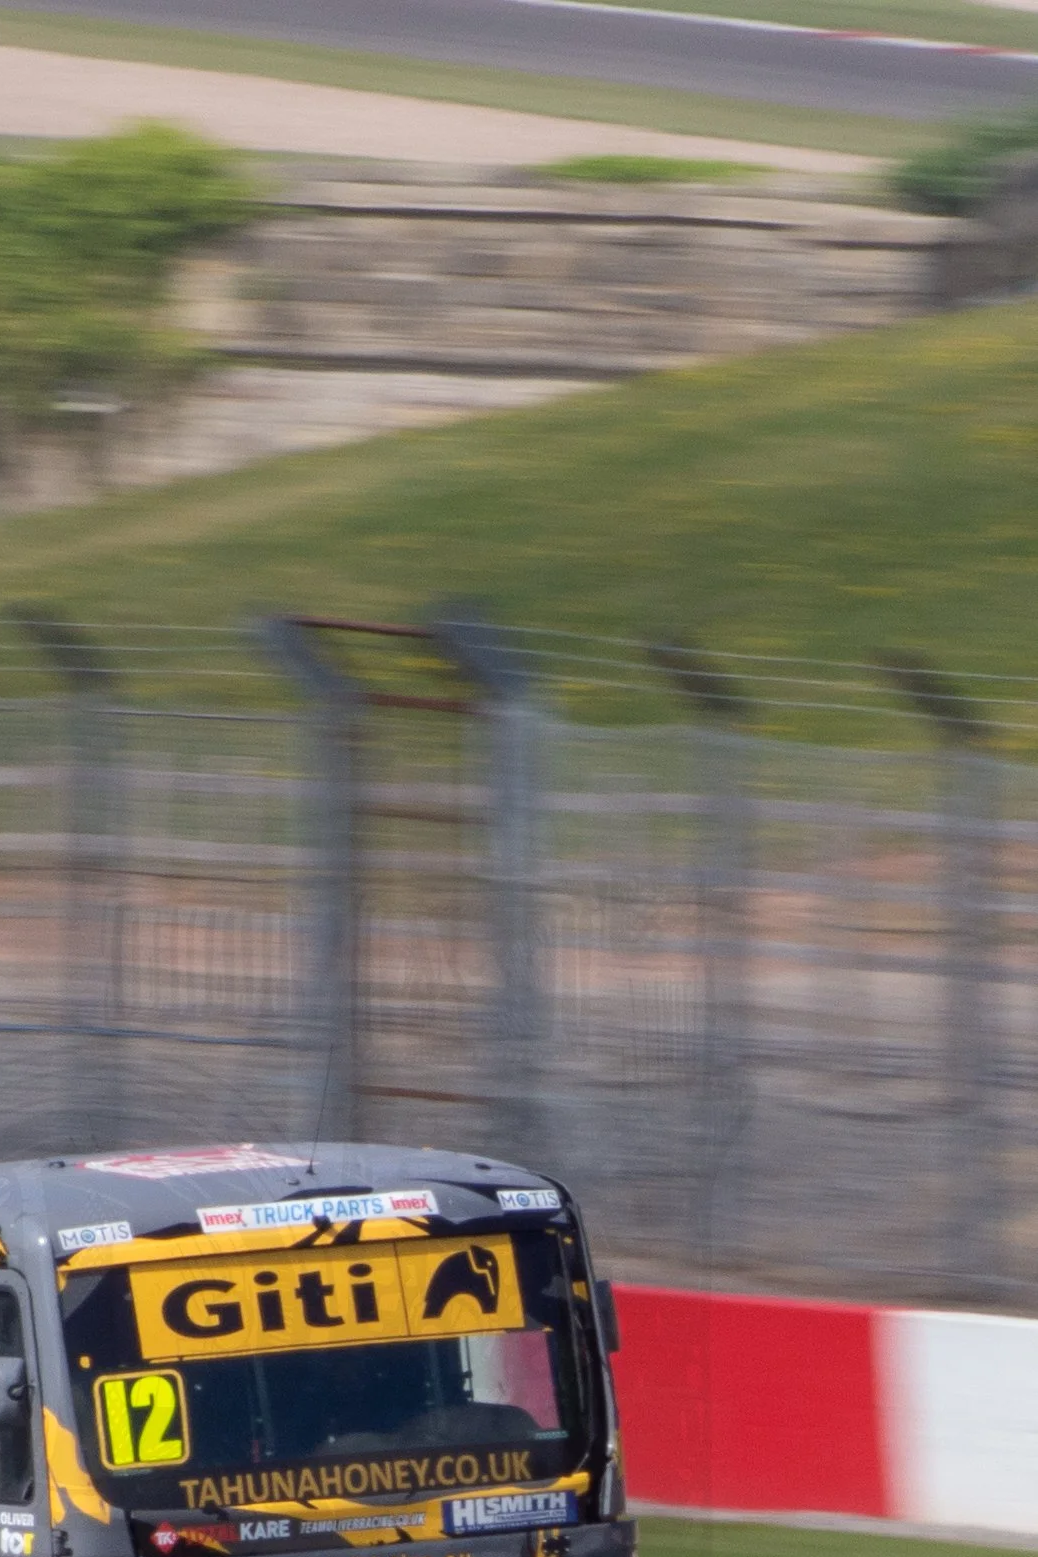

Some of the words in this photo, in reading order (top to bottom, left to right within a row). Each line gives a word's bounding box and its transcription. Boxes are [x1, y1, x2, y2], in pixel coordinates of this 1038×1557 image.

[203, 1208, 246, 1227] imex
[253, 1202, 315, 1225] TRUCK
[321, 1197, 384, 1219] PARTS
[390, 1193, 433, 1212] imex
[500, 1191, 559, 1208] MOTIS
[61, 1224, 130, 1248] MOTIS
[162, 1263, 380, 1339] Giti
[103, 1375, 183, 1466] 12
[179, 1450, 533, 1510] TAHUNAHONEY.CO.UK
[0, 1512, 35, 1527] OLIVER
